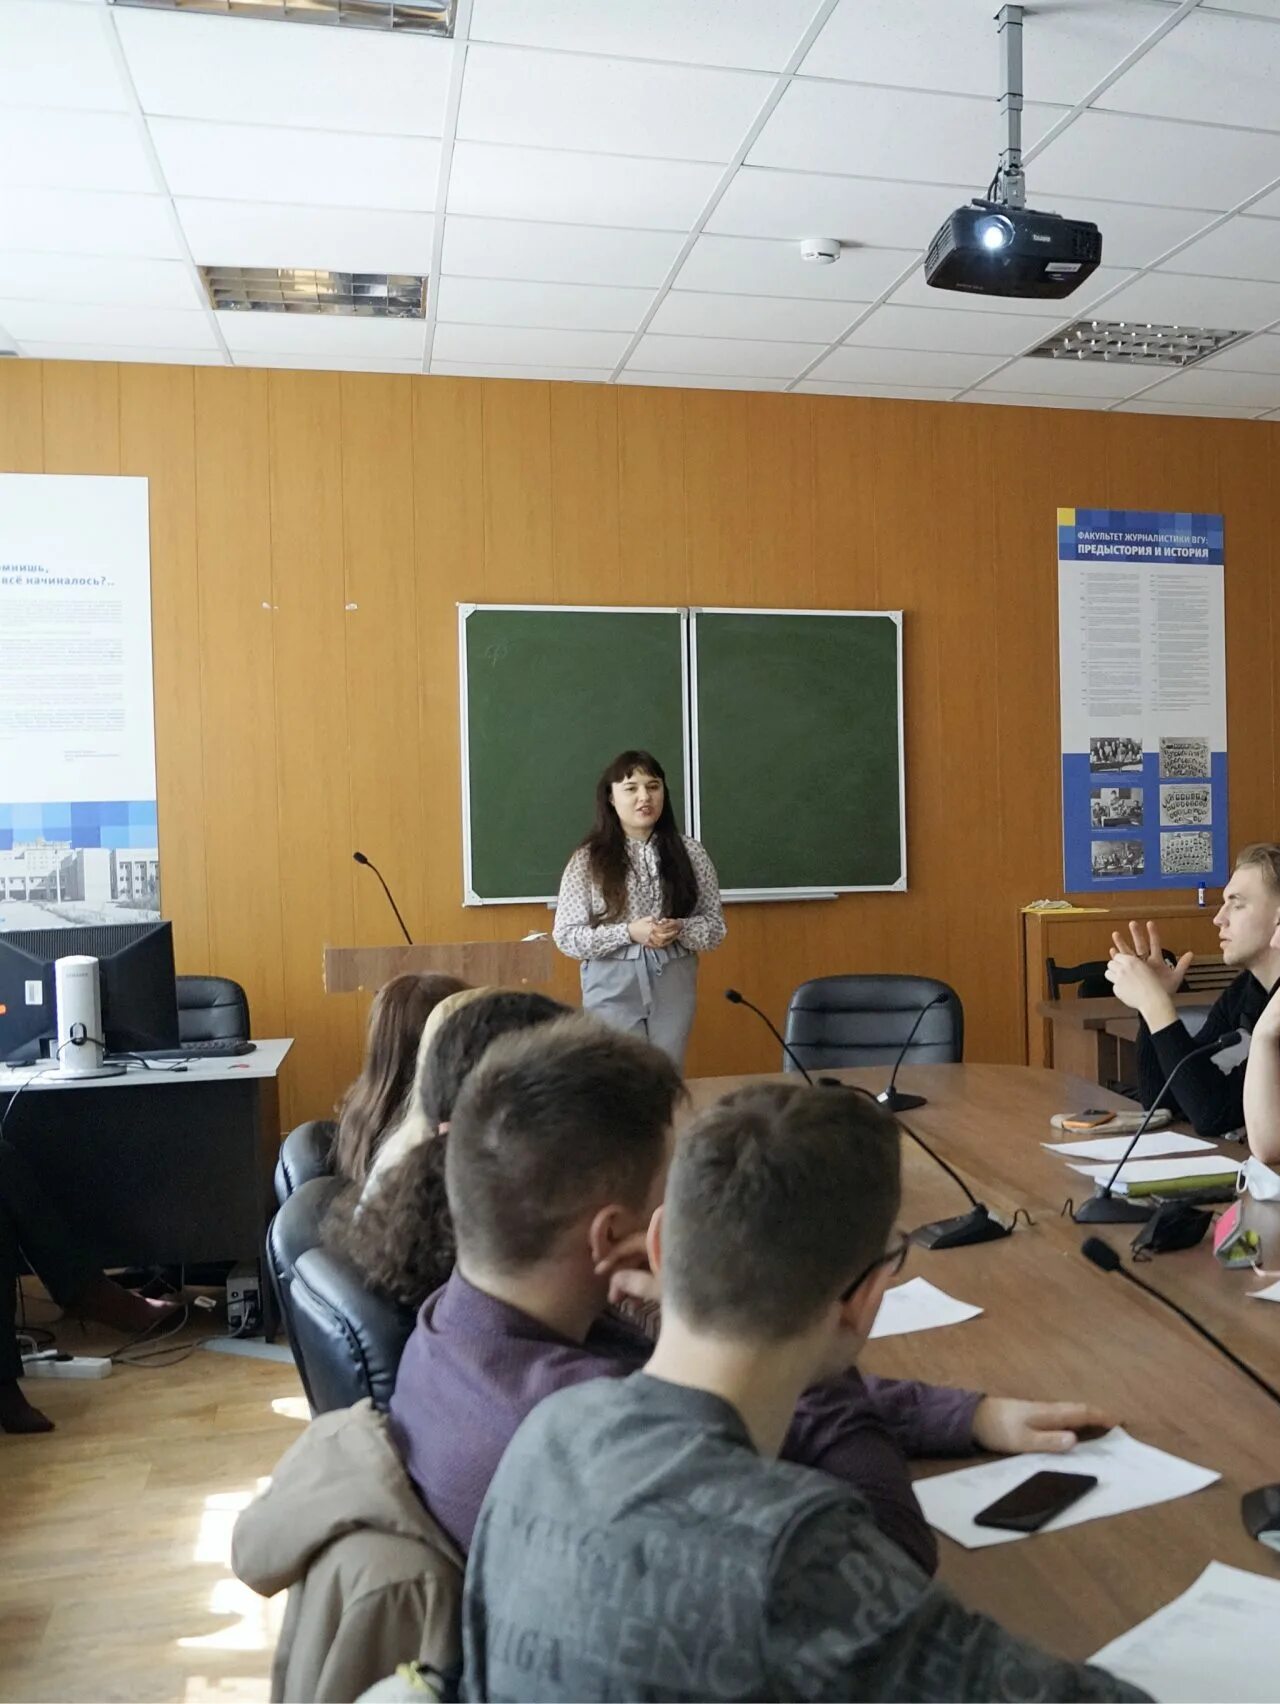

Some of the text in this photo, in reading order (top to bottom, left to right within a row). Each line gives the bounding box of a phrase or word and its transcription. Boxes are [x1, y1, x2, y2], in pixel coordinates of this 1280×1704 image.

[1077, 531, 1123, 541] ФАКУЛЬТЕТ
[1124, 533, 1190, 544] ЖУРНАЛИСТИКИ
[1077, 544, 1209, 558] ПРЕДЫСТОРИЯ И ИСТОРИЯ
[0, 565, 49, 574] мнишь,
